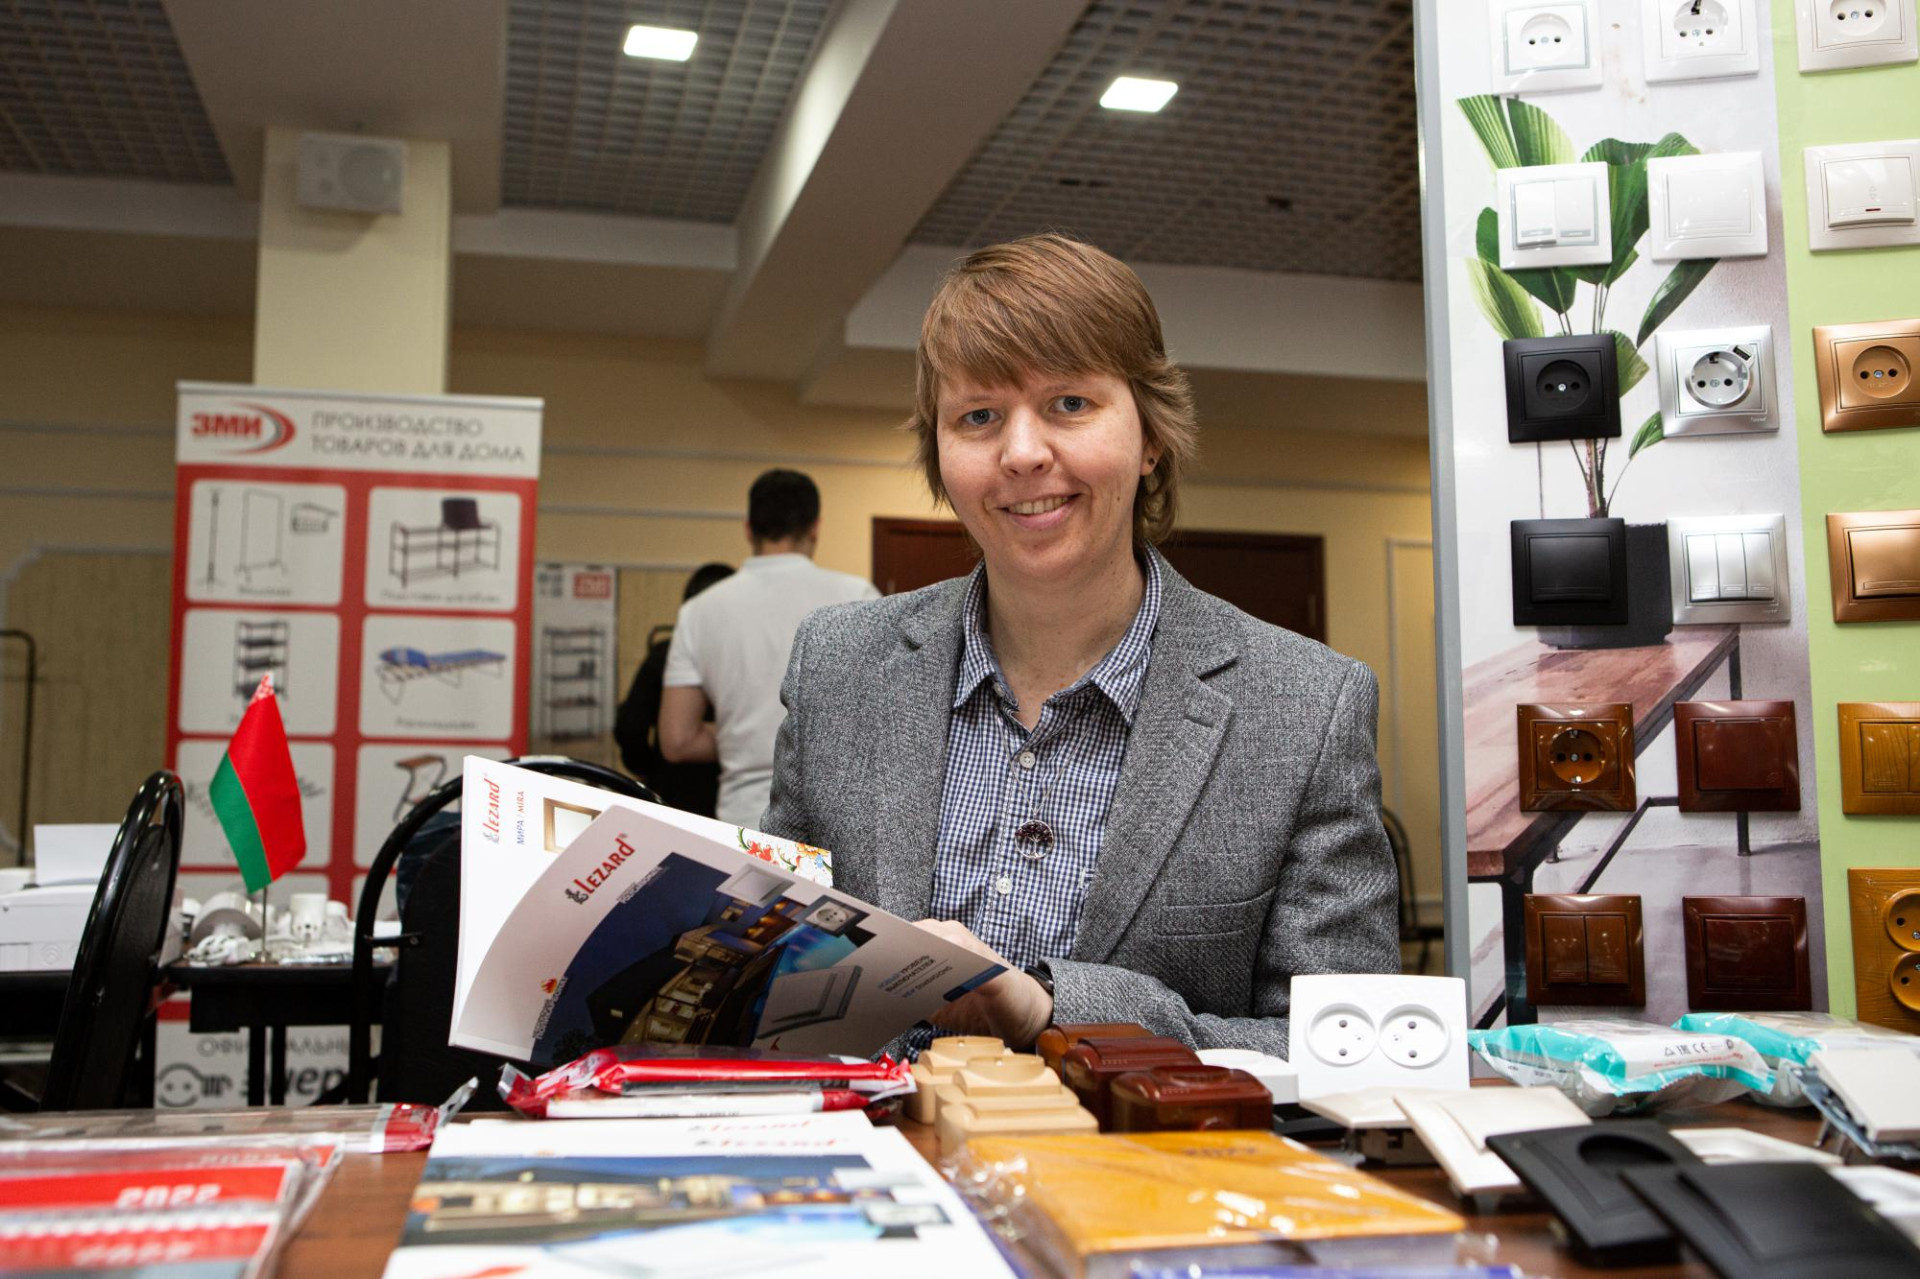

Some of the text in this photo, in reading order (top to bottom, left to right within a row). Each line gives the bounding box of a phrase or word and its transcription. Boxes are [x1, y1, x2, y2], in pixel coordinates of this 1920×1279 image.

[192, 413, 262, 439] ЗМИ
[312, 411, 484, 438] ПРОИЗВОДСТВО
[311, 436, 526, 463] ТОВАРОВ ДЛЯ ДОМА
[516, 791, 525, 814] MIRA
[516, 820, 525, 846] МИРА
